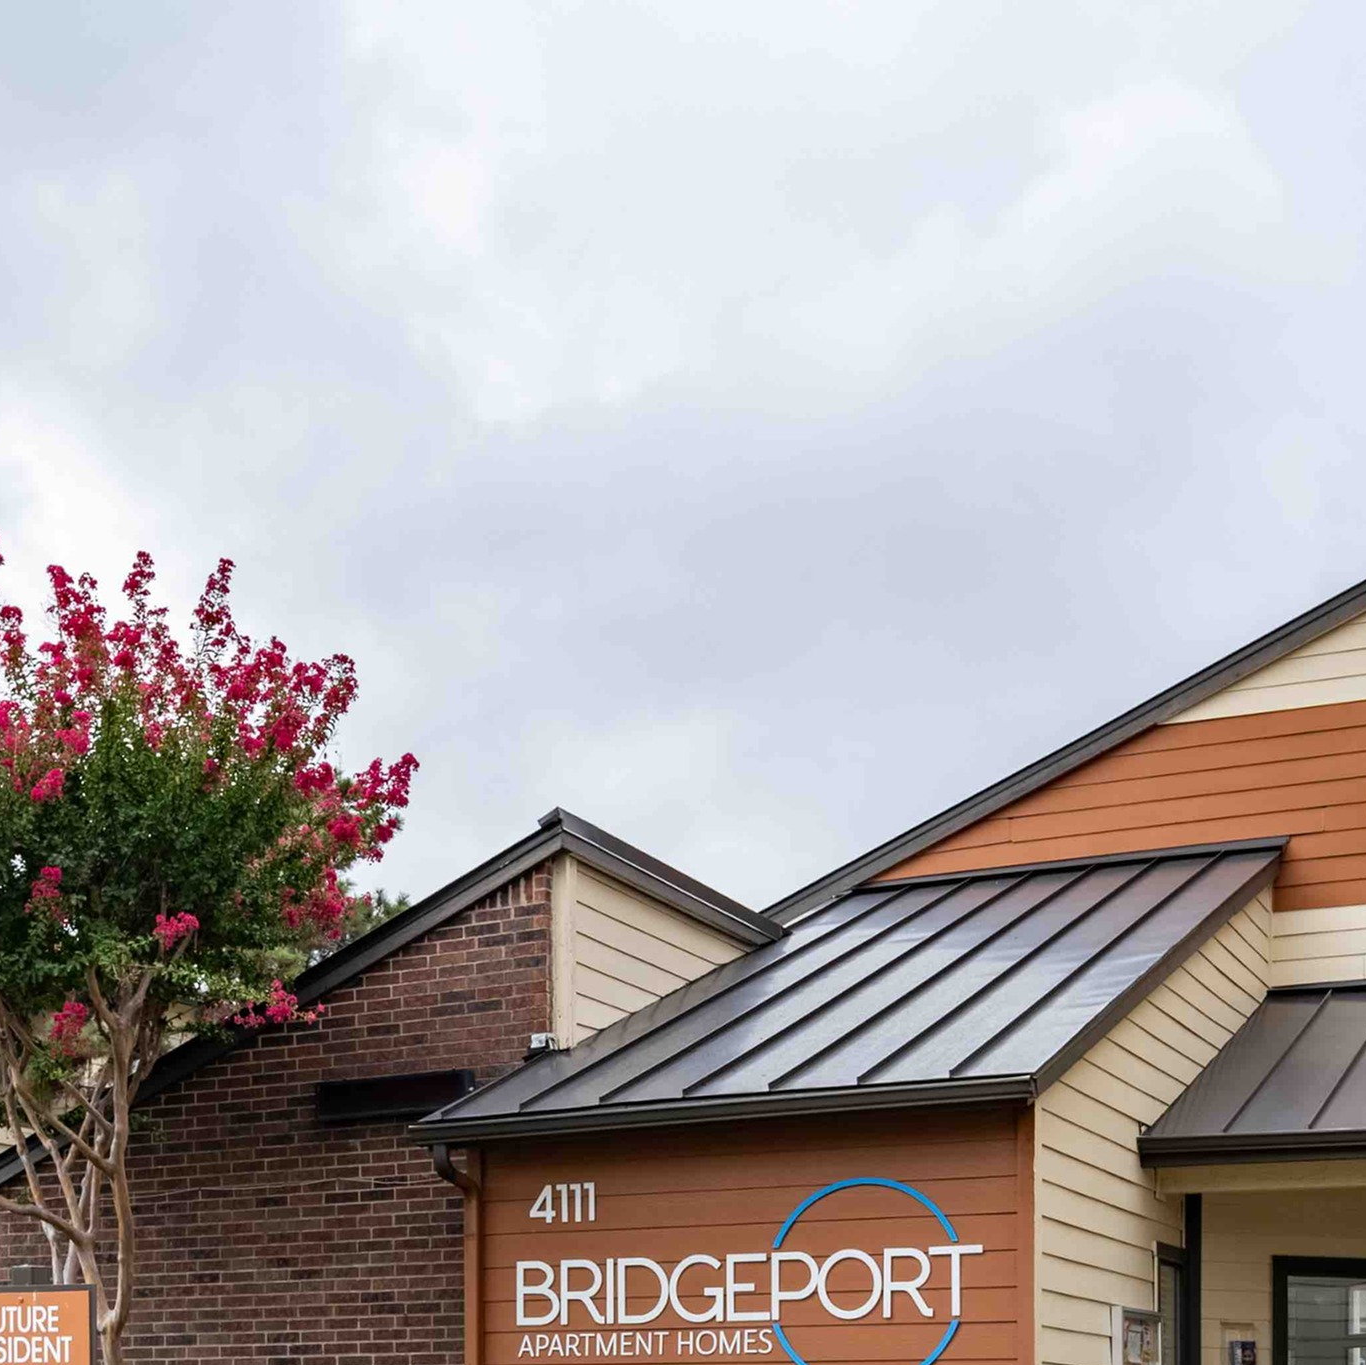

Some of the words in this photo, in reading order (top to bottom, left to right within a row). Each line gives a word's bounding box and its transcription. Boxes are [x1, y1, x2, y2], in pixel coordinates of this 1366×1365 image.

[529, 1181, 597, 1224] 4111
[515, 1243, 984, 1327] BRIDGEPORT
[517, 1331, 670, 1358] APARTMENT
[676, 1329, 774, 1356] HOMES
